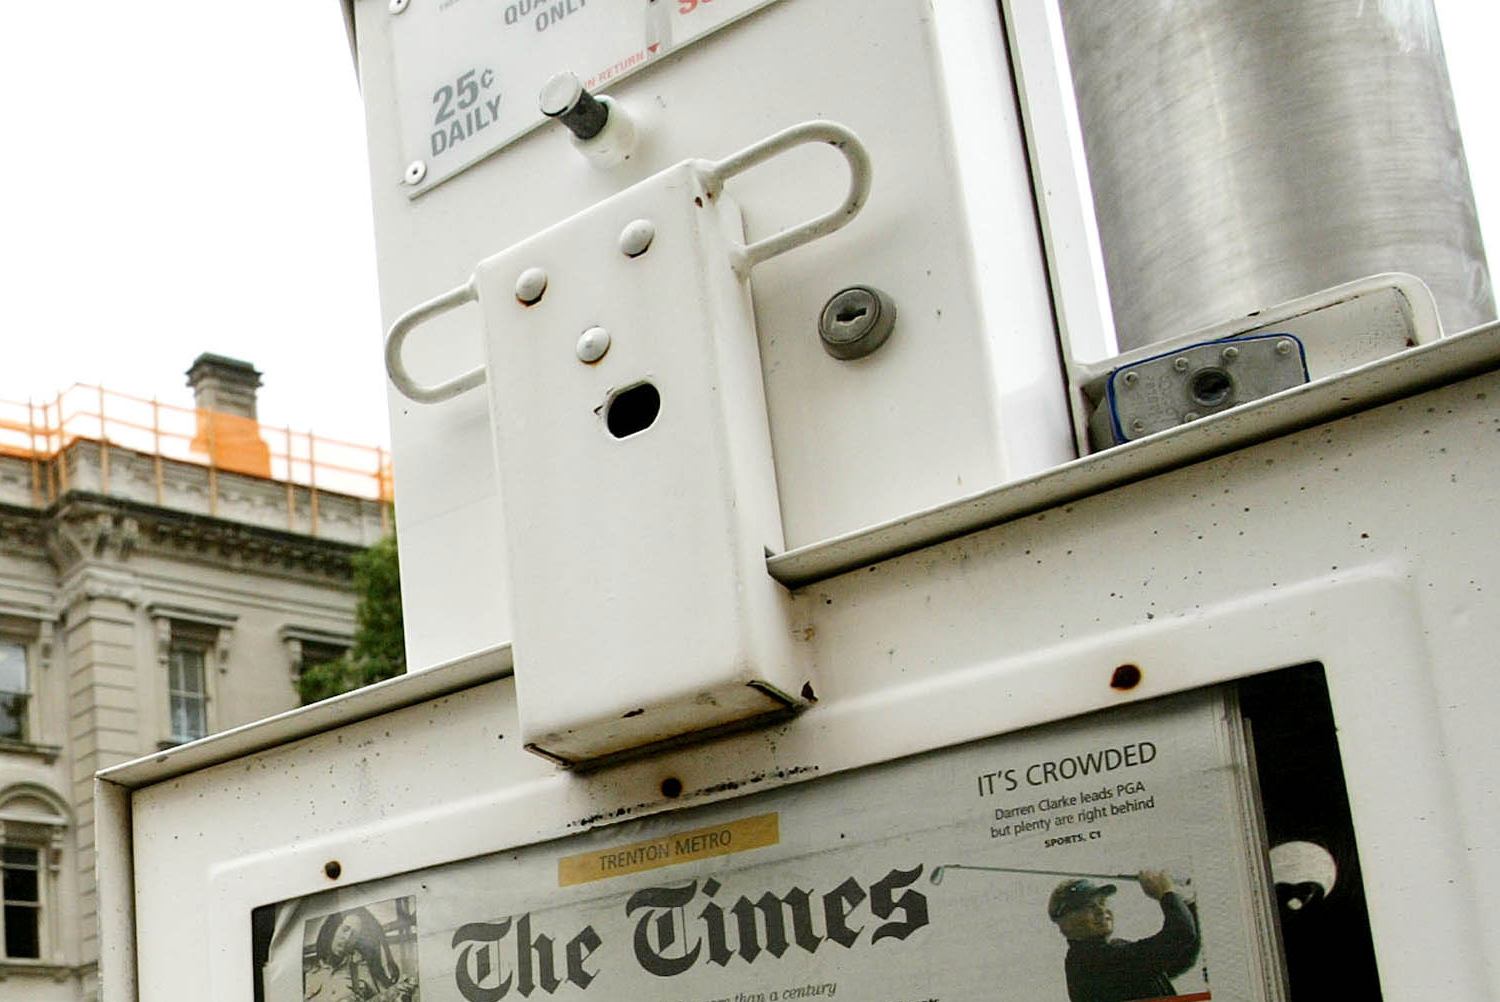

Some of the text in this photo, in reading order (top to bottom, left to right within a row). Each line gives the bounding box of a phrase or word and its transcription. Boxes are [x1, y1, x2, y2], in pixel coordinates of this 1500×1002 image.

[598, 51, 646, 81] RETURN
[431, 93, 502, 157] DAILY
[977, 741, 1157, 797] IT'S CROWDED
[990, 796, 1155, 838] but plenty are right behind
[995, 781, 1145, 821] Darren Clarke leads PGA
[599, 829, 733, 873] TRENTON METRO
[626, 863, 931, 977] Times
[769, 991, 778, 1001] a
[782, 982, 837, 1000] century
